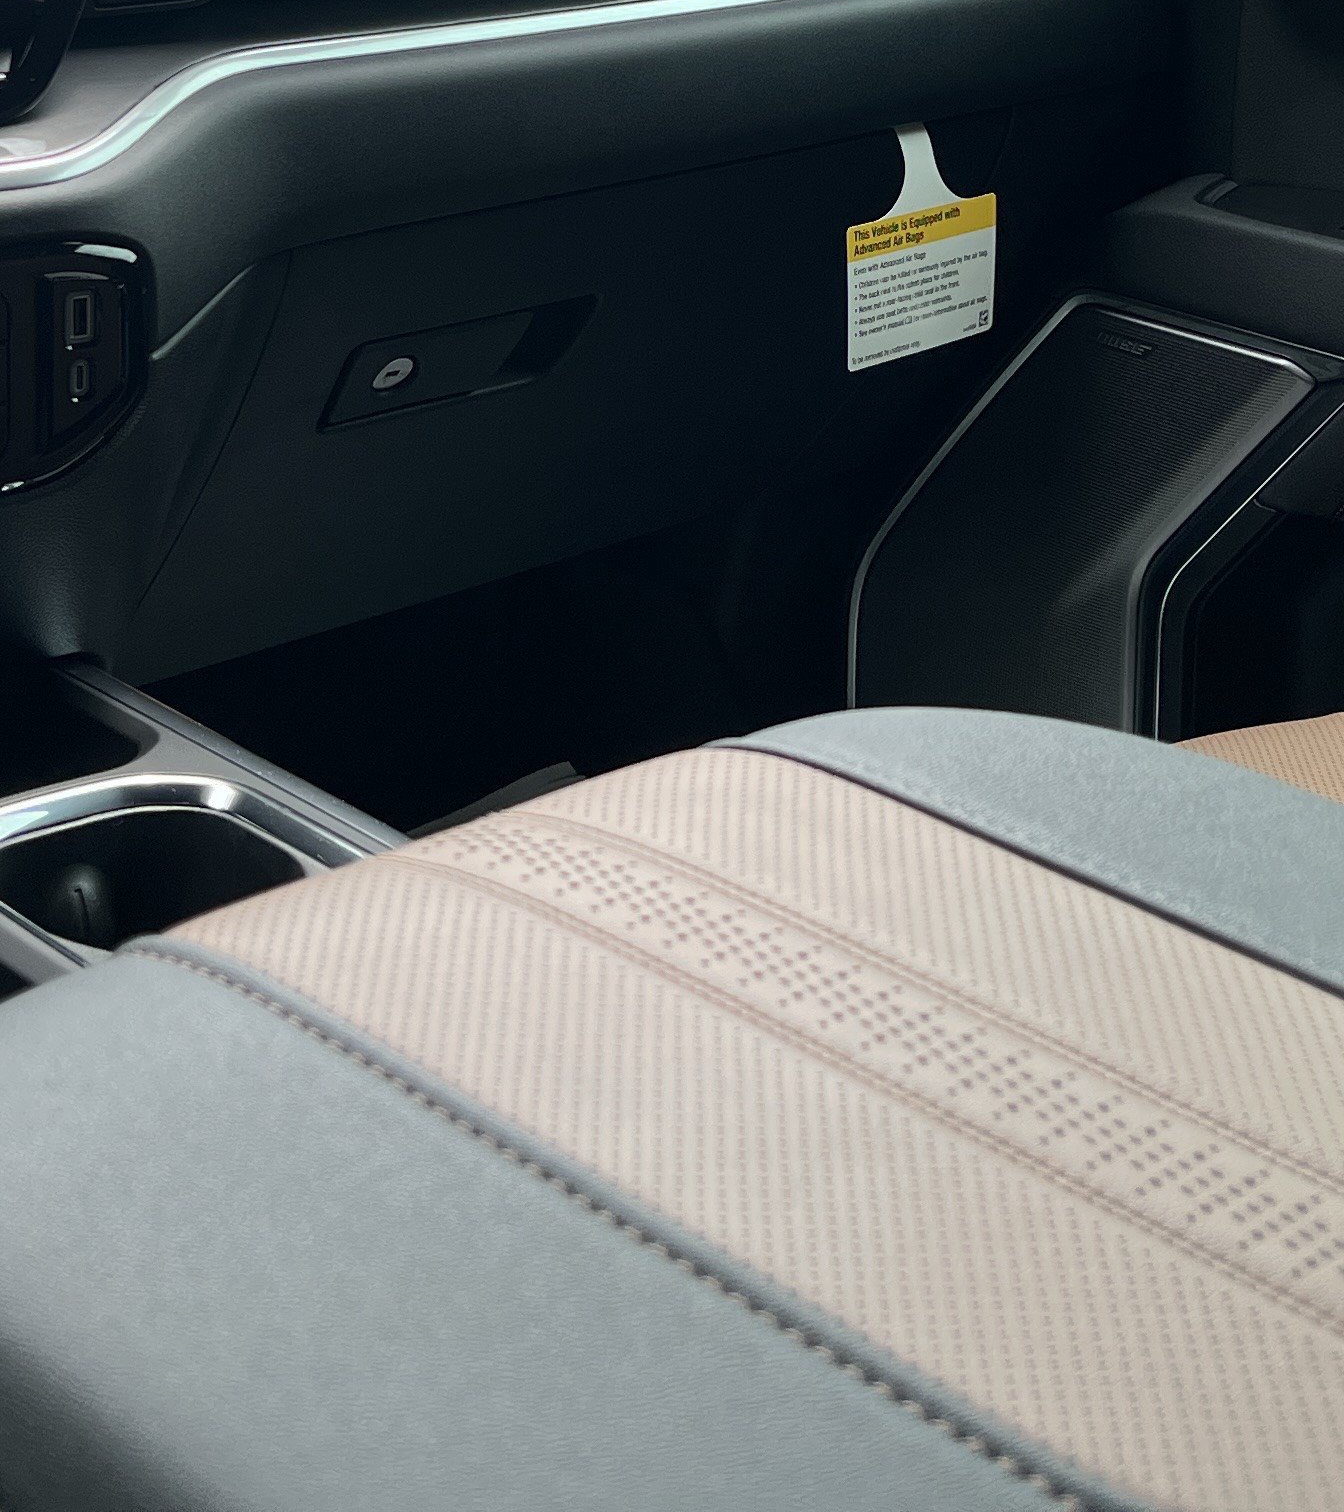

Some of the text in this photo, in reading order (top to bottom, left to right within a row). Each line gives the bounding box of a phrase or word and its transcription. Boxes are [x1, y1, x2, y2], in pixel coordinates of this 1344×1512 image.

[854, 206, 960, 242] This Vehicle is Equipped with
[853, 229, 924, 256] Advanced Air Bags
